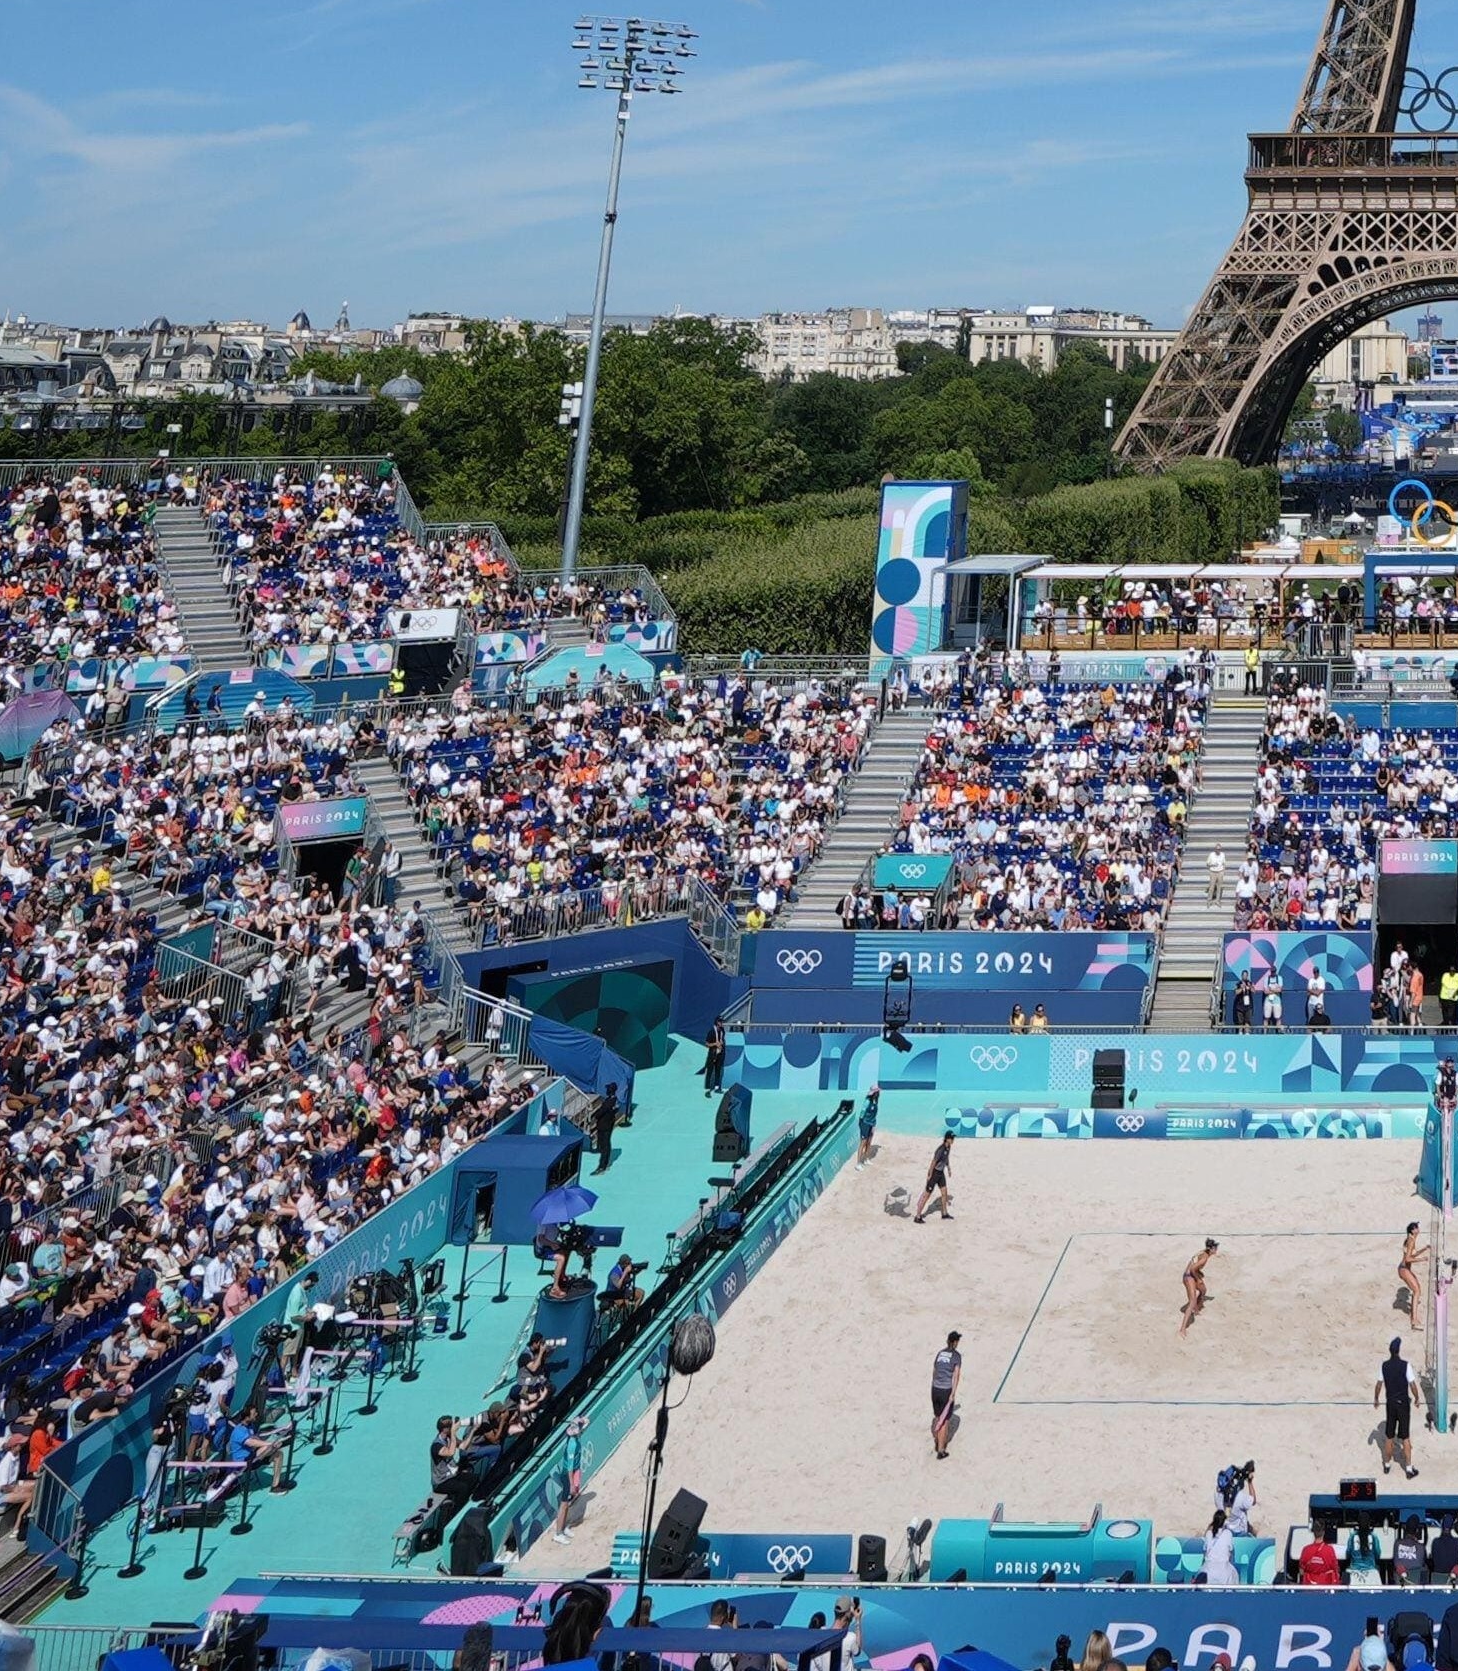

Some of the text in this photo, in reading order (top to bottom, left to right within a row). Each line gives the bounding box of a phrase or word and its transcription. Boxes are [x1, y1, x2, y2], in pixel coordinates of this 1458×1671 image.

[285, 809, 359, 827] PARIS 2024
[1387, 853, 1453, 862] PARIS 2024
[878, 951, 1053, 974] PARIS 2024
[1074, 1049, 1257, 1073] PIS 2024
[1172, 1118, 1237, 1129] PARIS 2024
[397, 1194, 449, 1252] 2024
[995, 1561, 1081, 1575] PARIS 2024
